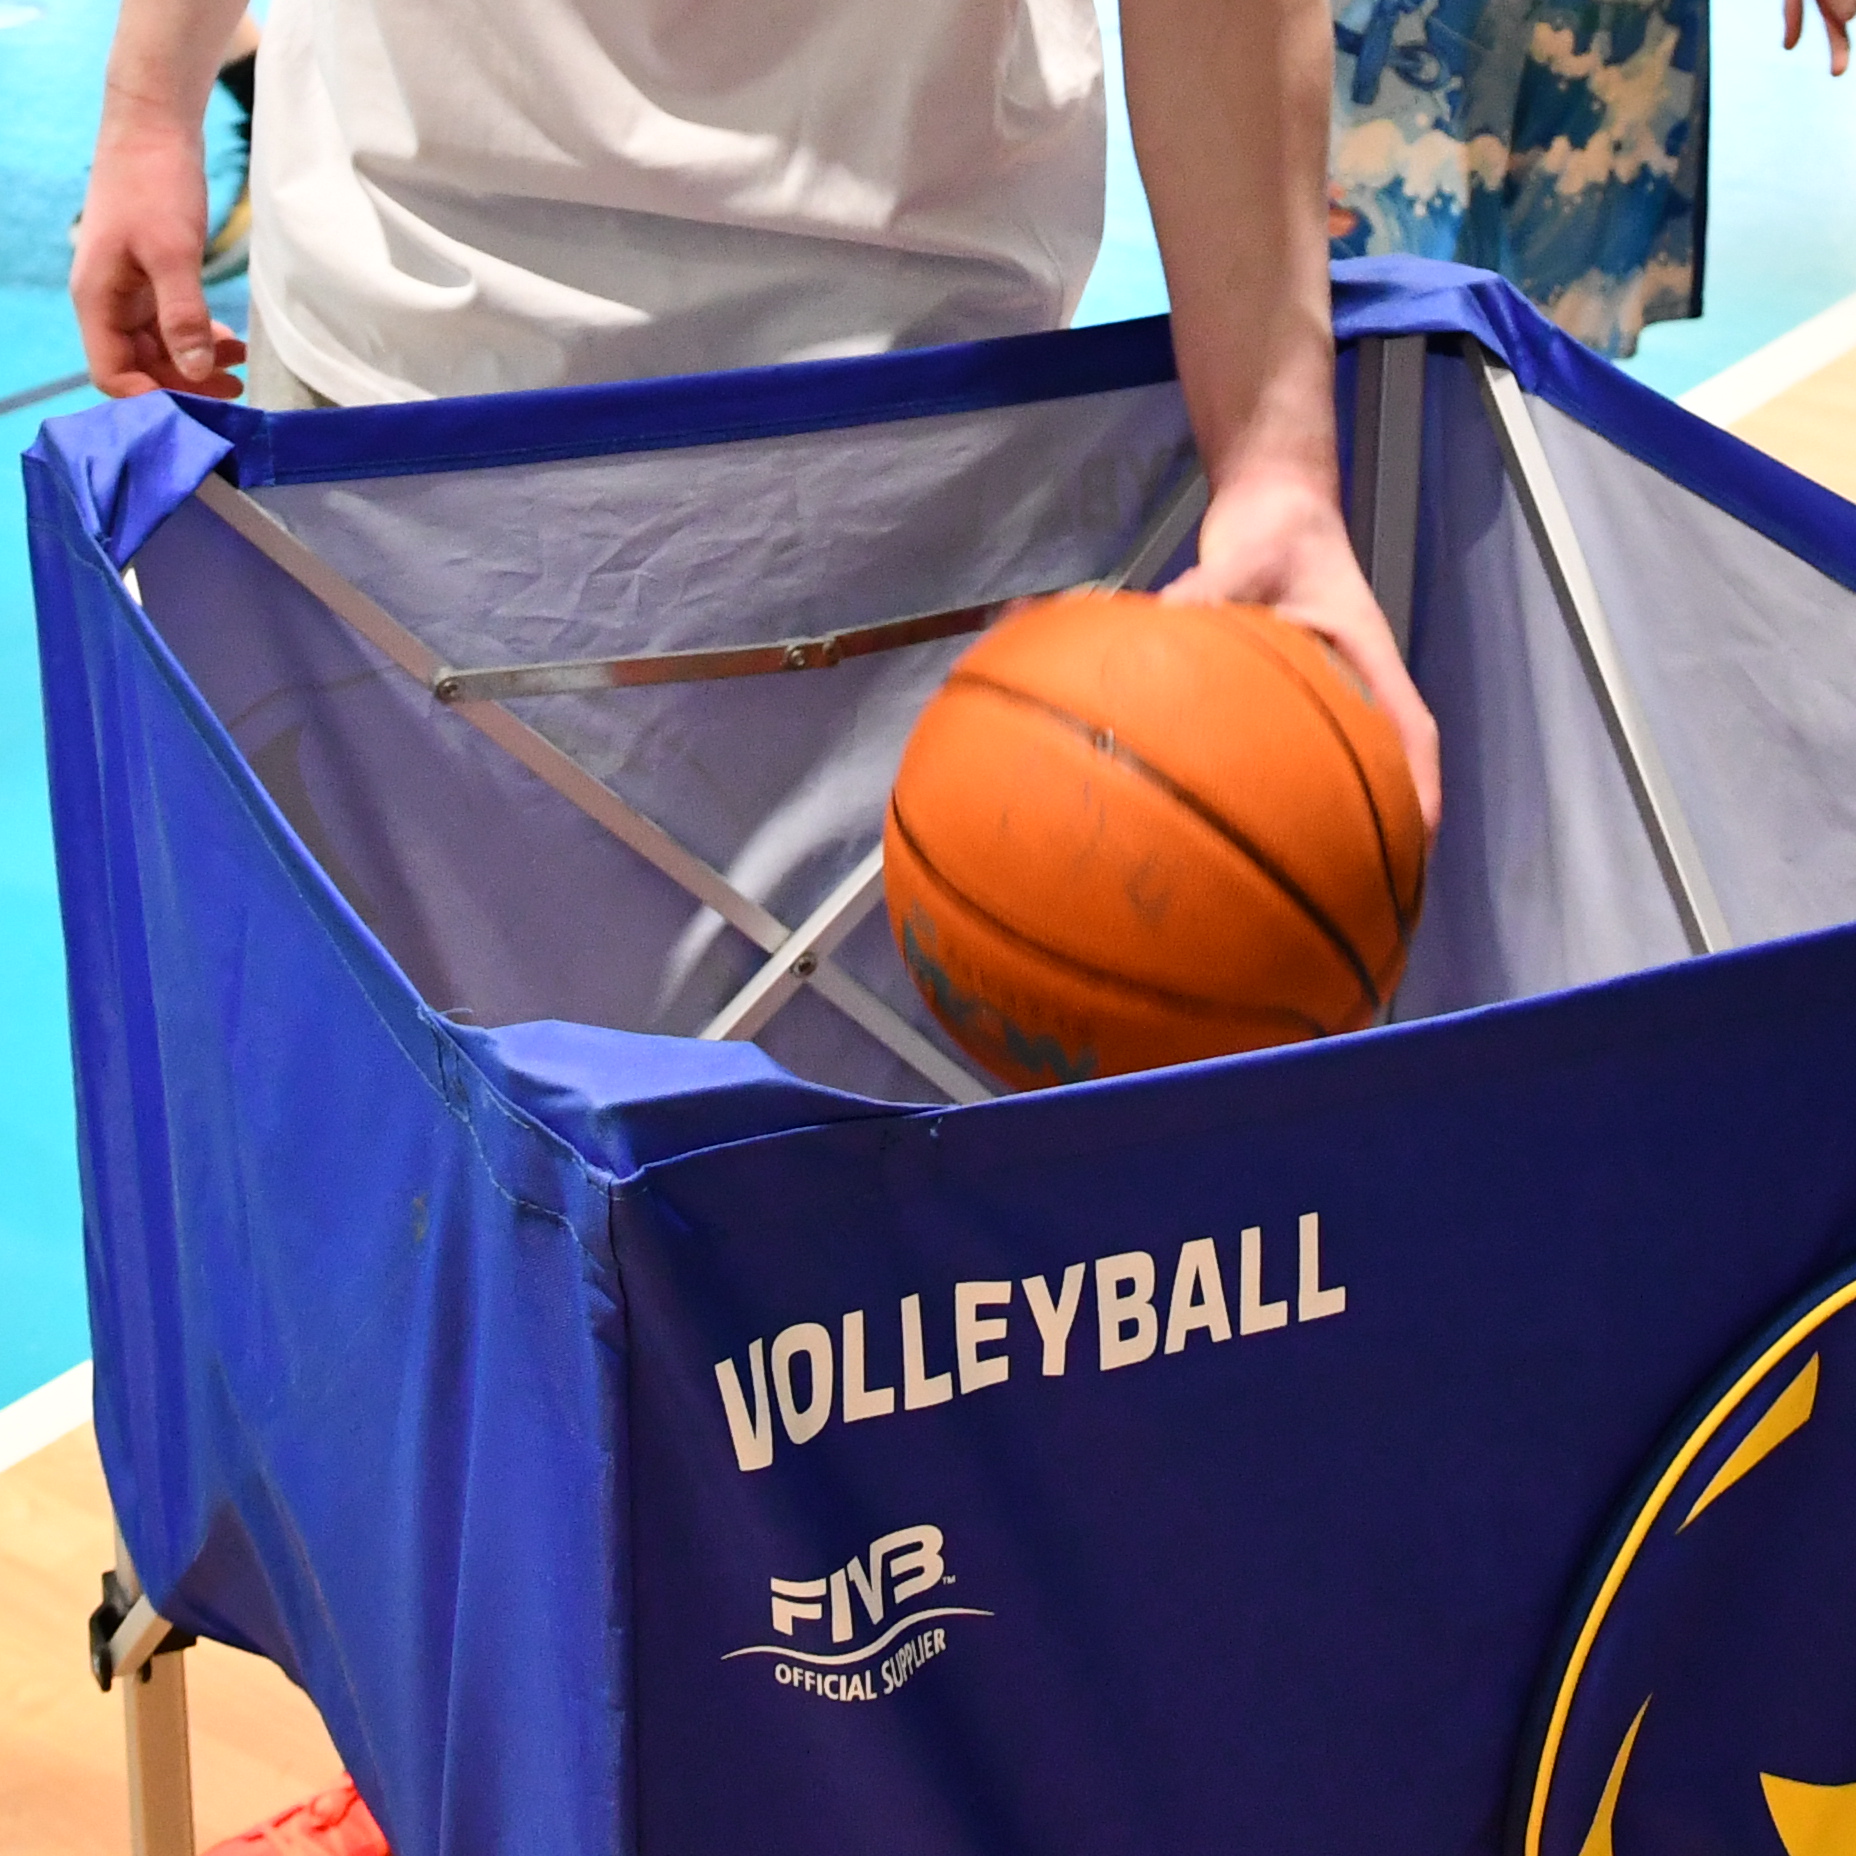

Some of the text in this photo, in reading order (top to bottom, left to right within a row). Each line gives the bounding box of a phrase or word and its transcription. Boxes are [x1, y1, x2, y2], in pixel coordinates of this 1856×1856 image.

[714, 1211, 1346, 1471] VOLLEYBALL
[770, 1524, 945, 1643] FIVB
[775, 1628, 947, 1702] OFFICIAL SUPPLIER
